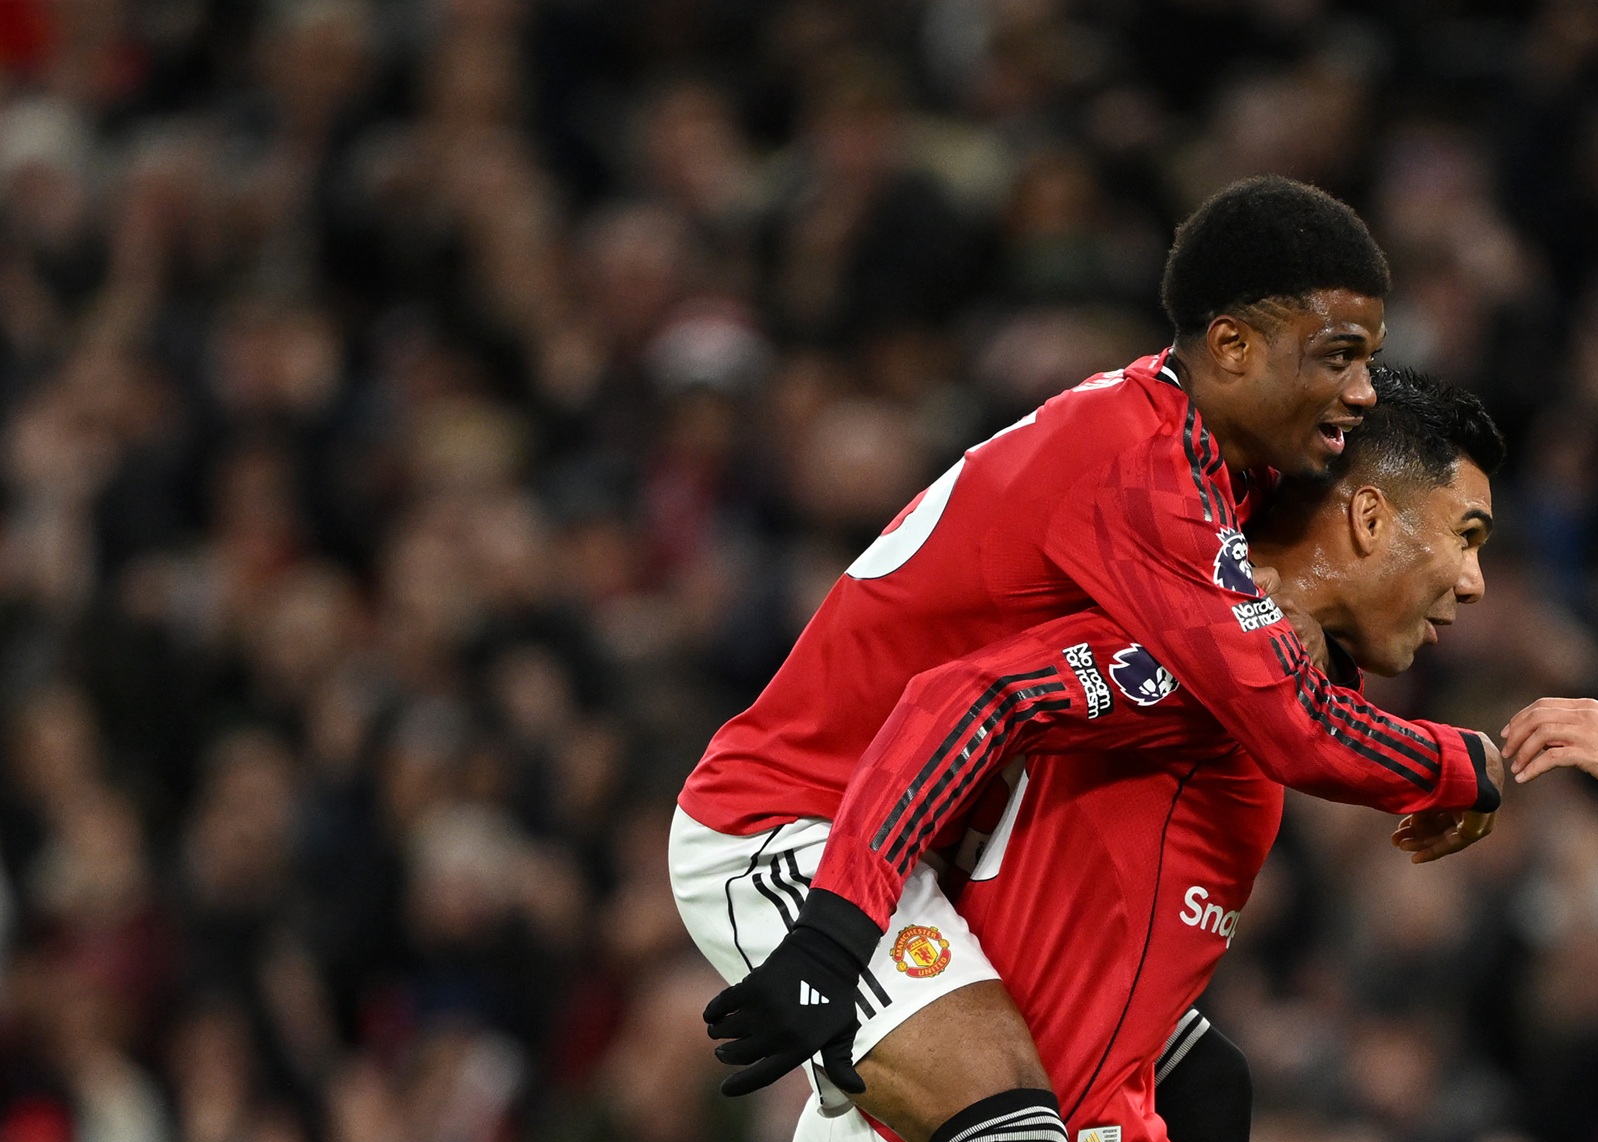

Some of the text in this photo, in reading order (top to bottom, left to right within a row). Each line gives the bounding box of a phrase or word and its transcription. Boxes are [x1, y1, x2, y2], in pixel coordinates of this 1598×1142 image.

[1232, 603, 1254, 618] No
[1074, 642, 1111, 710] No room
[1075, 669, 1099, 719] racism
[895, 928, 937, 957] MANCHESTER
[918, 957, 947, 975] UNITED
